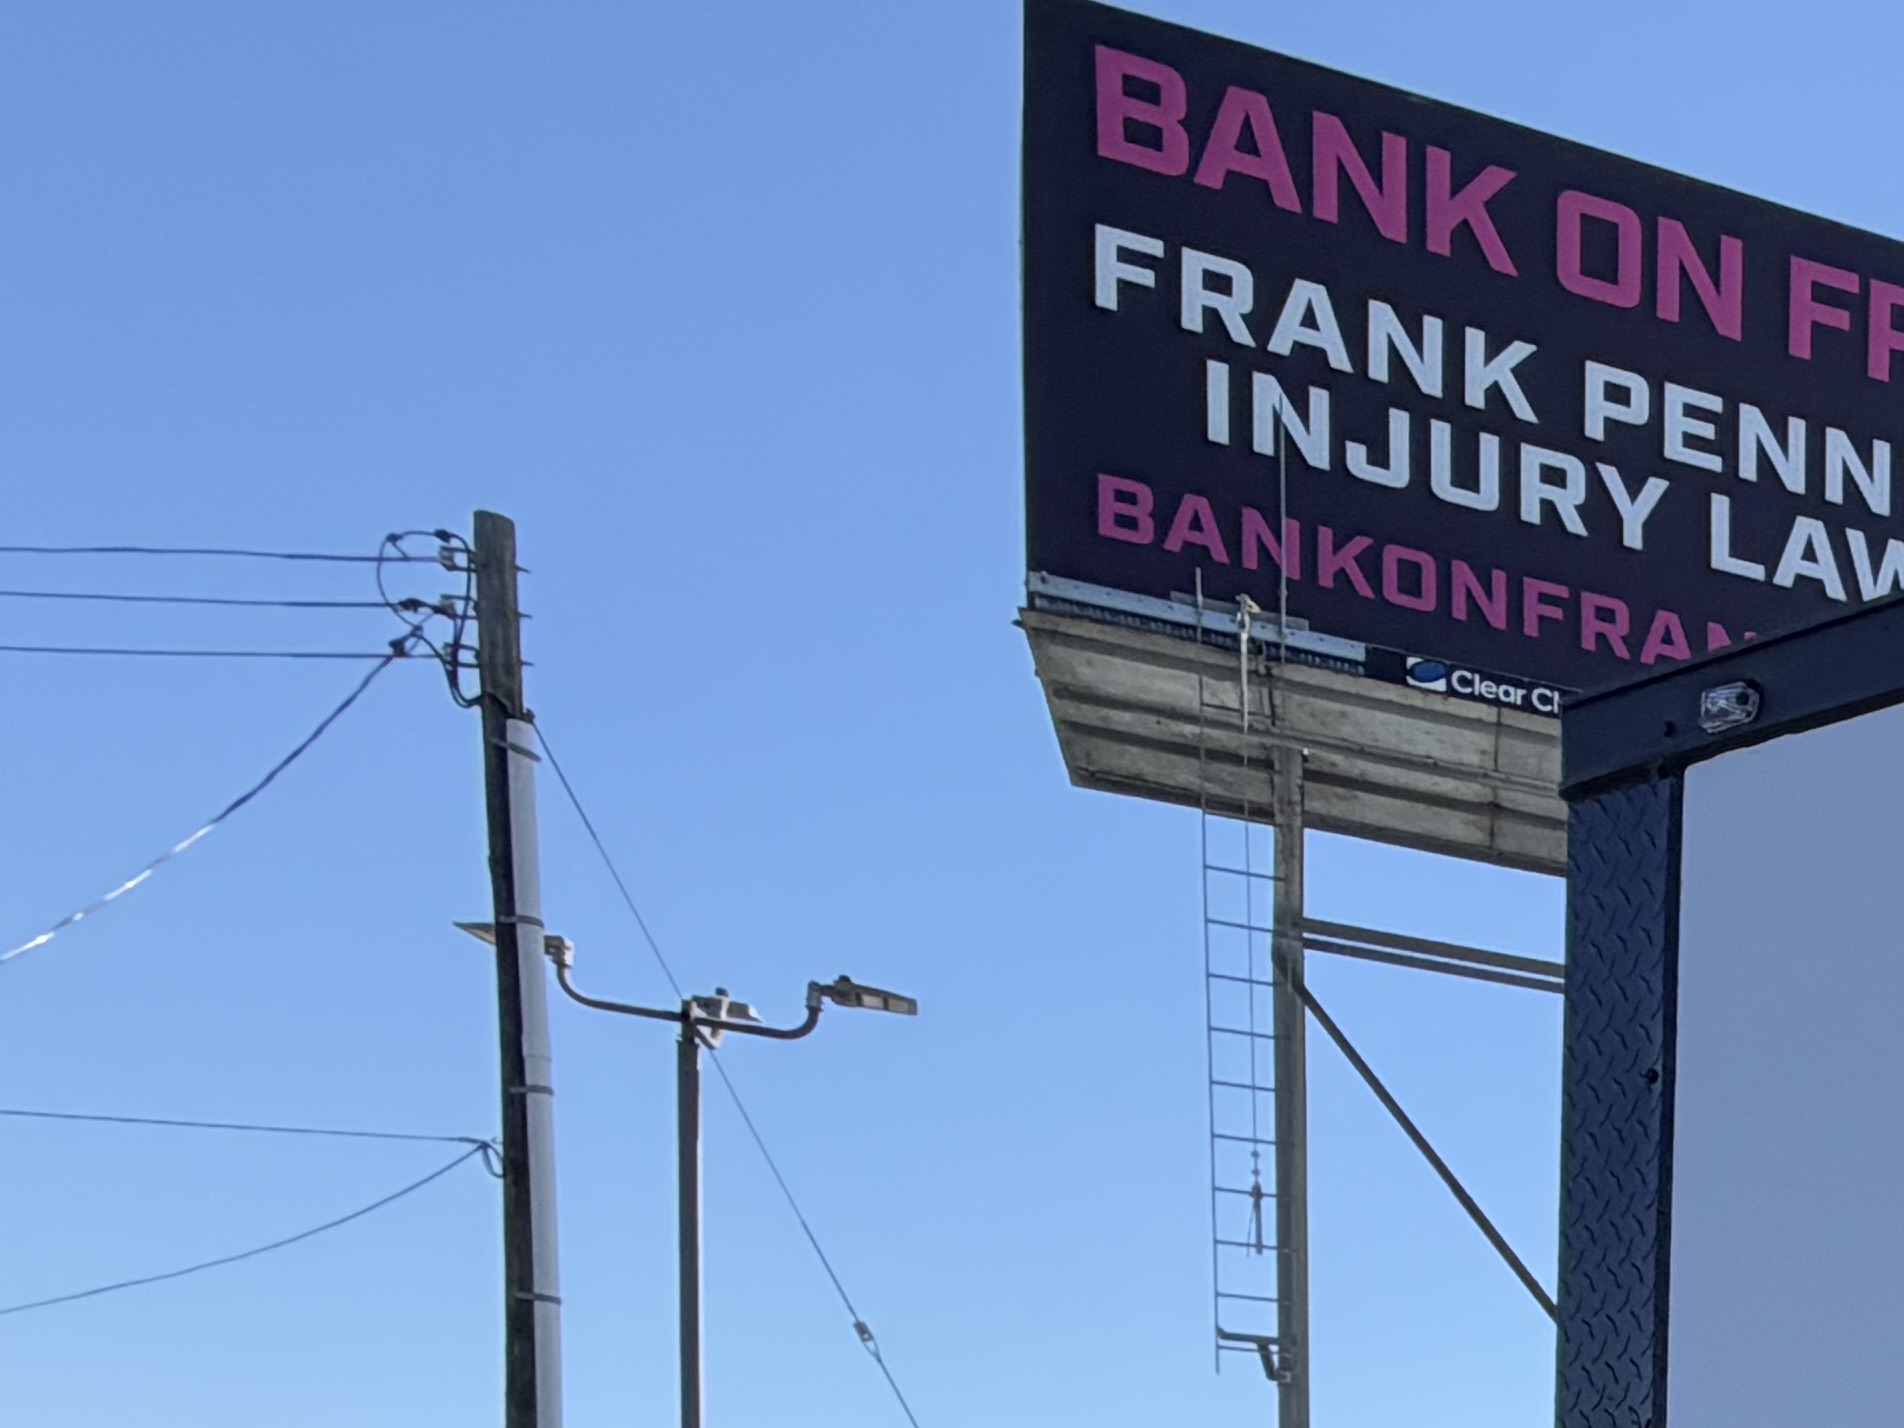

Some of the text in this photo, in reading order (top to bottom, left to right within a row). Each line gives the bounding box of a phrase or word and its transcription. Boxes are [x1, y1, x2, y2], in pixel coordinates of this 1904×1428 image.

[1093, 43, 1518, 277] BANK
[1556, 187, 1744, 342] ON
[1093, 222, 1539, 424] FRANK
[1206, 359, 1670, 551] INJURY
[1097, 473, 1757, 665] BANKONFRA
[1450, 669, 1528, 706] Clear
